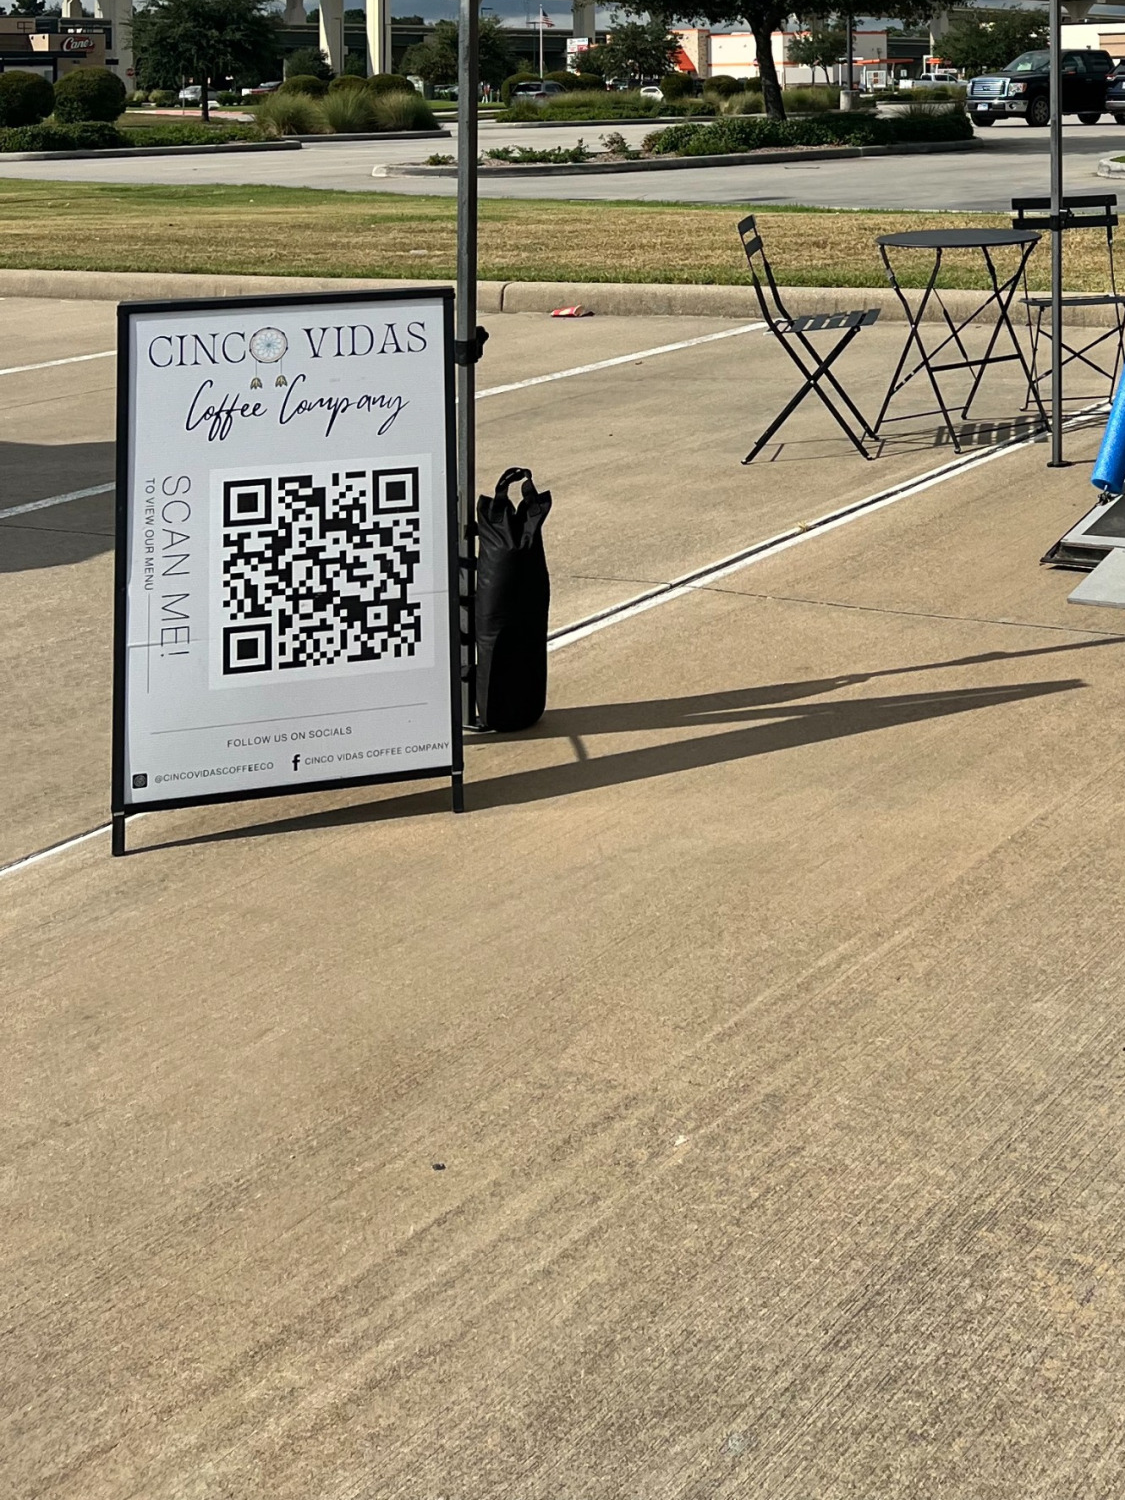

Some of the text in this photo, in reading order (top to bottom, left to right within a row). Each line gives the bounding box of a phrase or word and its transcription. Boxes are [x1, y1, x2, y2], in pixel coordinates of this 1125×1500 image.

[148, 321, 428, 368] CINCO VIDAS
[185, 373, 411, 442] Coffee Company
[144, 477, 155, 591] TO VIEW OUR MENU
[161, 475, 191, 657] SCAN ME!
[226, 726, 352, 748] FOLLOW US ON SOCIALS
[304, 754, 335, 766] CINCO
[336, 750, 364, 762] VIDAS
[366, 746, 402, 759] COFFEE
[404, 741, 449, 754] COMPANY
[154, 761, 274, 784] @CINCOVIDASCOFFEECO
